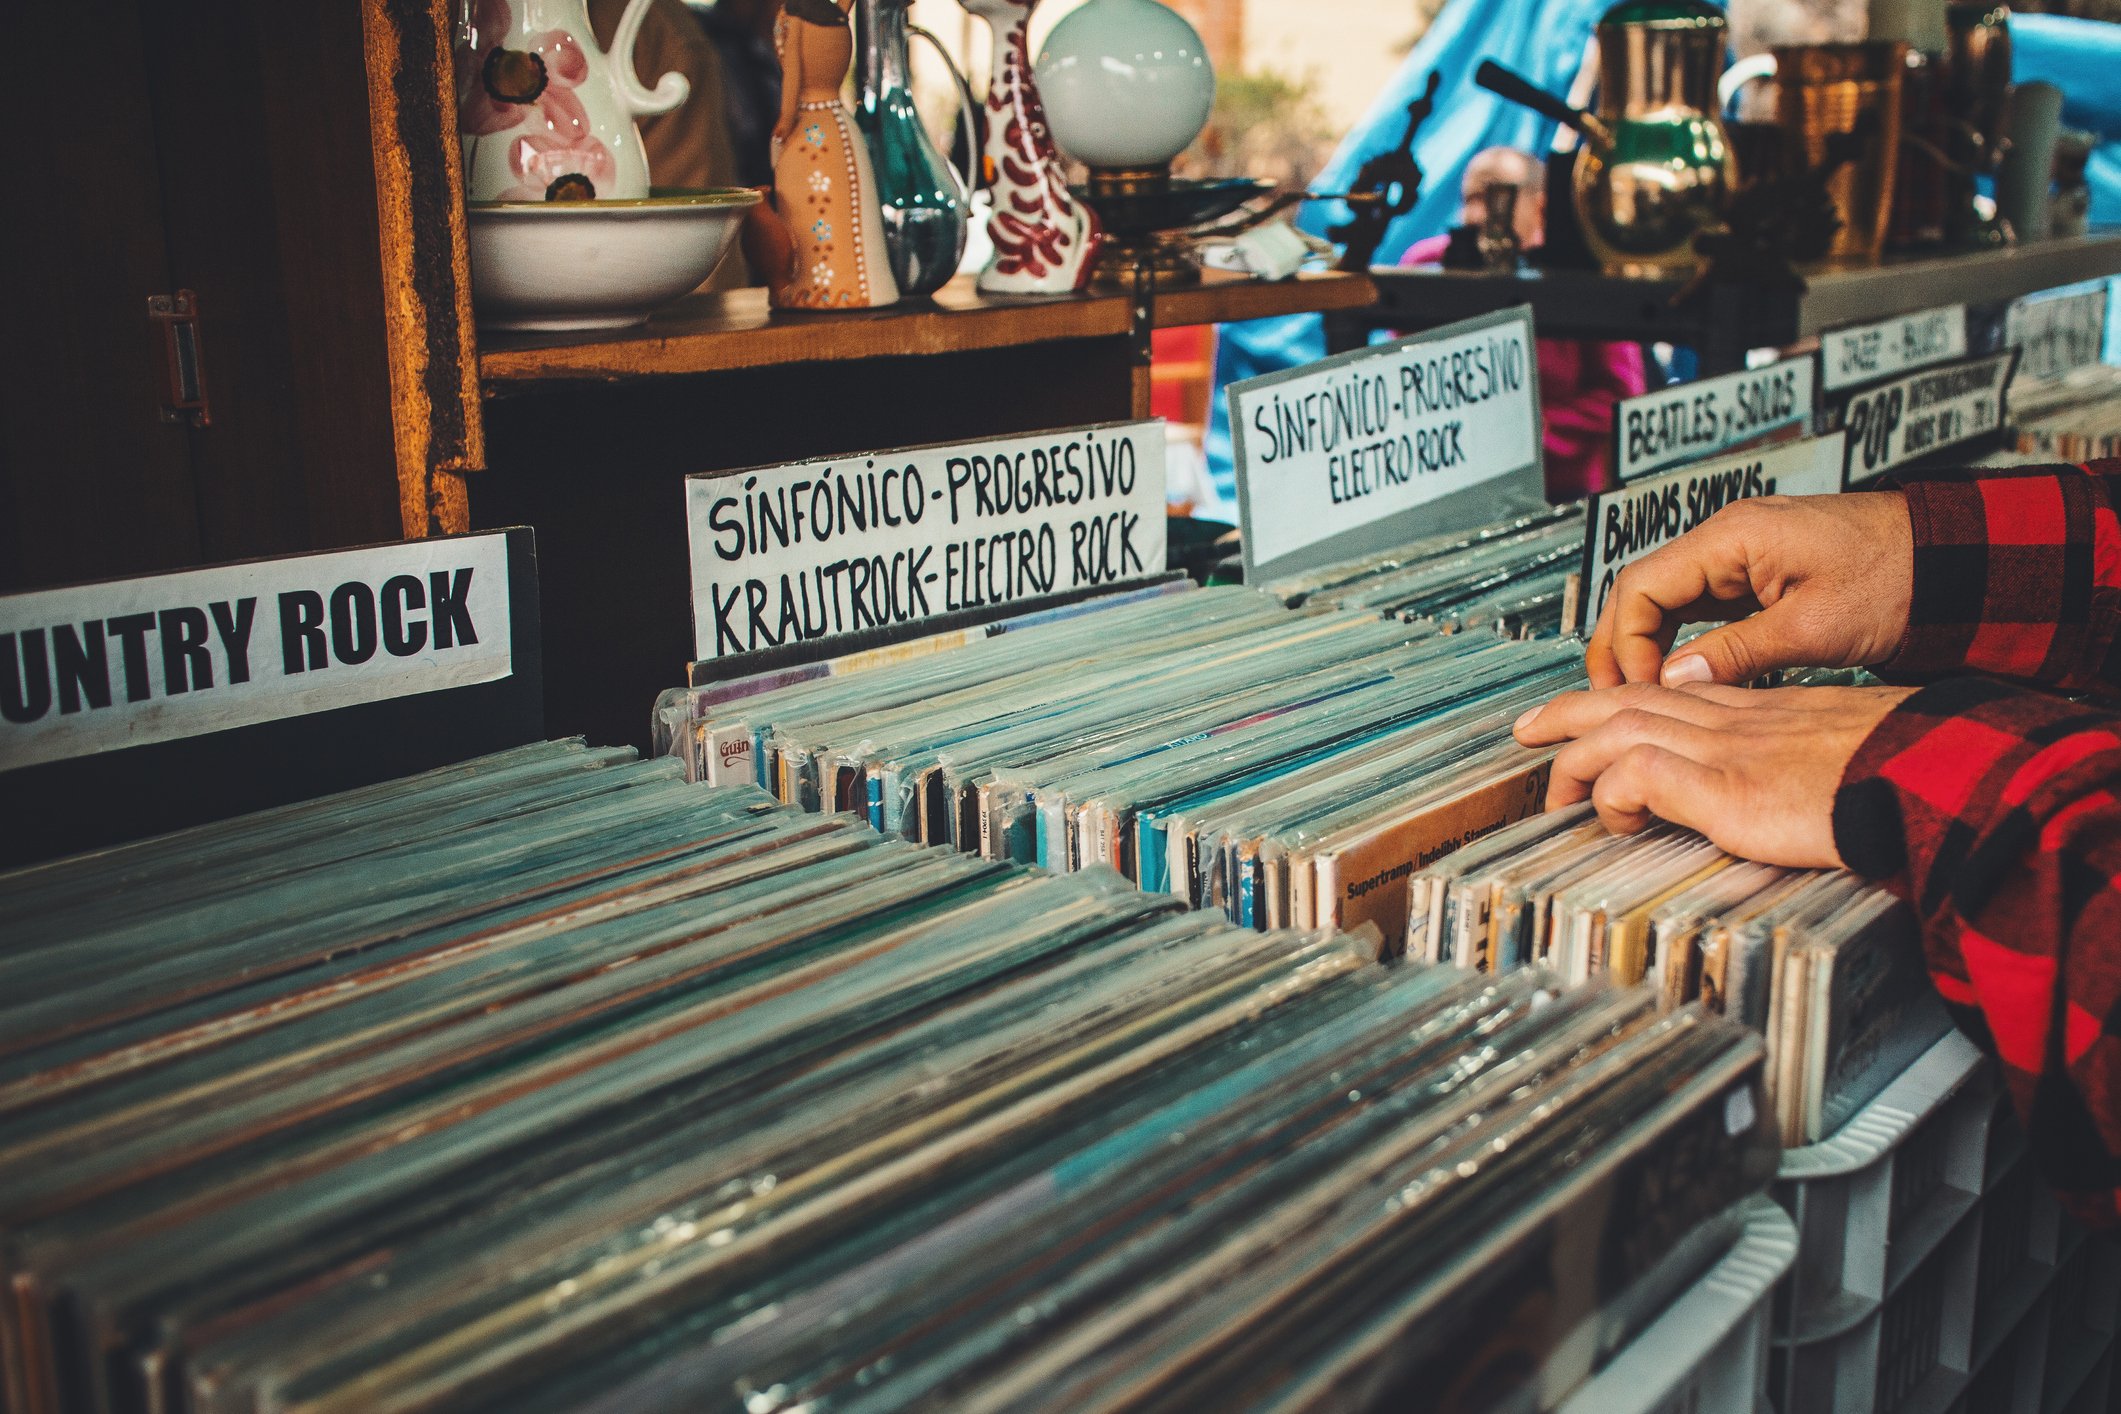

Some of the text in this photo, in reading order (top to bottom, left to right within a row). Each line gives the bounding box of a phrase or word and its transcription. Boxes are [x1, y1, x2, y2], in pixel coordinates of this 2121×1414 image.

[1627, 392, 1717, 463] BEATLES
[1736, 370, 1795, 430] SOLOS
[1848, 387, 1902, 470] POP
[1329, 420, 1466, 504] ELECTRO ROCK
[1603, 482, 1681, 564] BANDAS
[711, 510, 1143, 657] KRAUTROCK-ELECTRO ROCK
[0, 567, 479, 724] UNTRY ROCK
